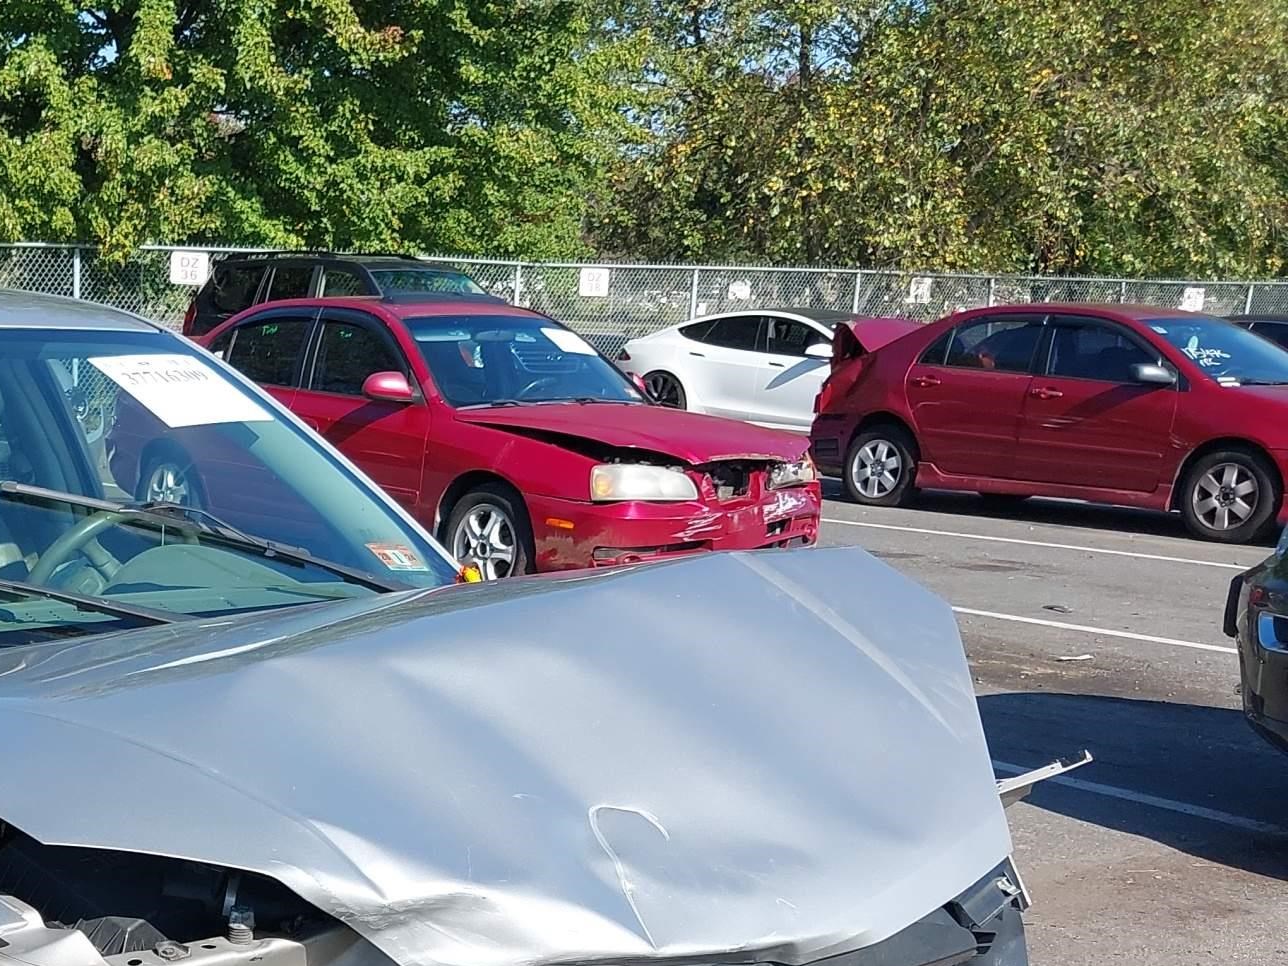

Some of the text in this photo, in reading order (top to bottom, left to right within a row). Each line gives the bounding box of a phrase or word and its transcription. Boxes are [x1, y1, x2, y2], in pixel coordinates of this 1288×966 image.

[180, 257, 200, 268] DZ
[181, 270, 198, 280] 36
[120, 369, 209, 386] 37716309
